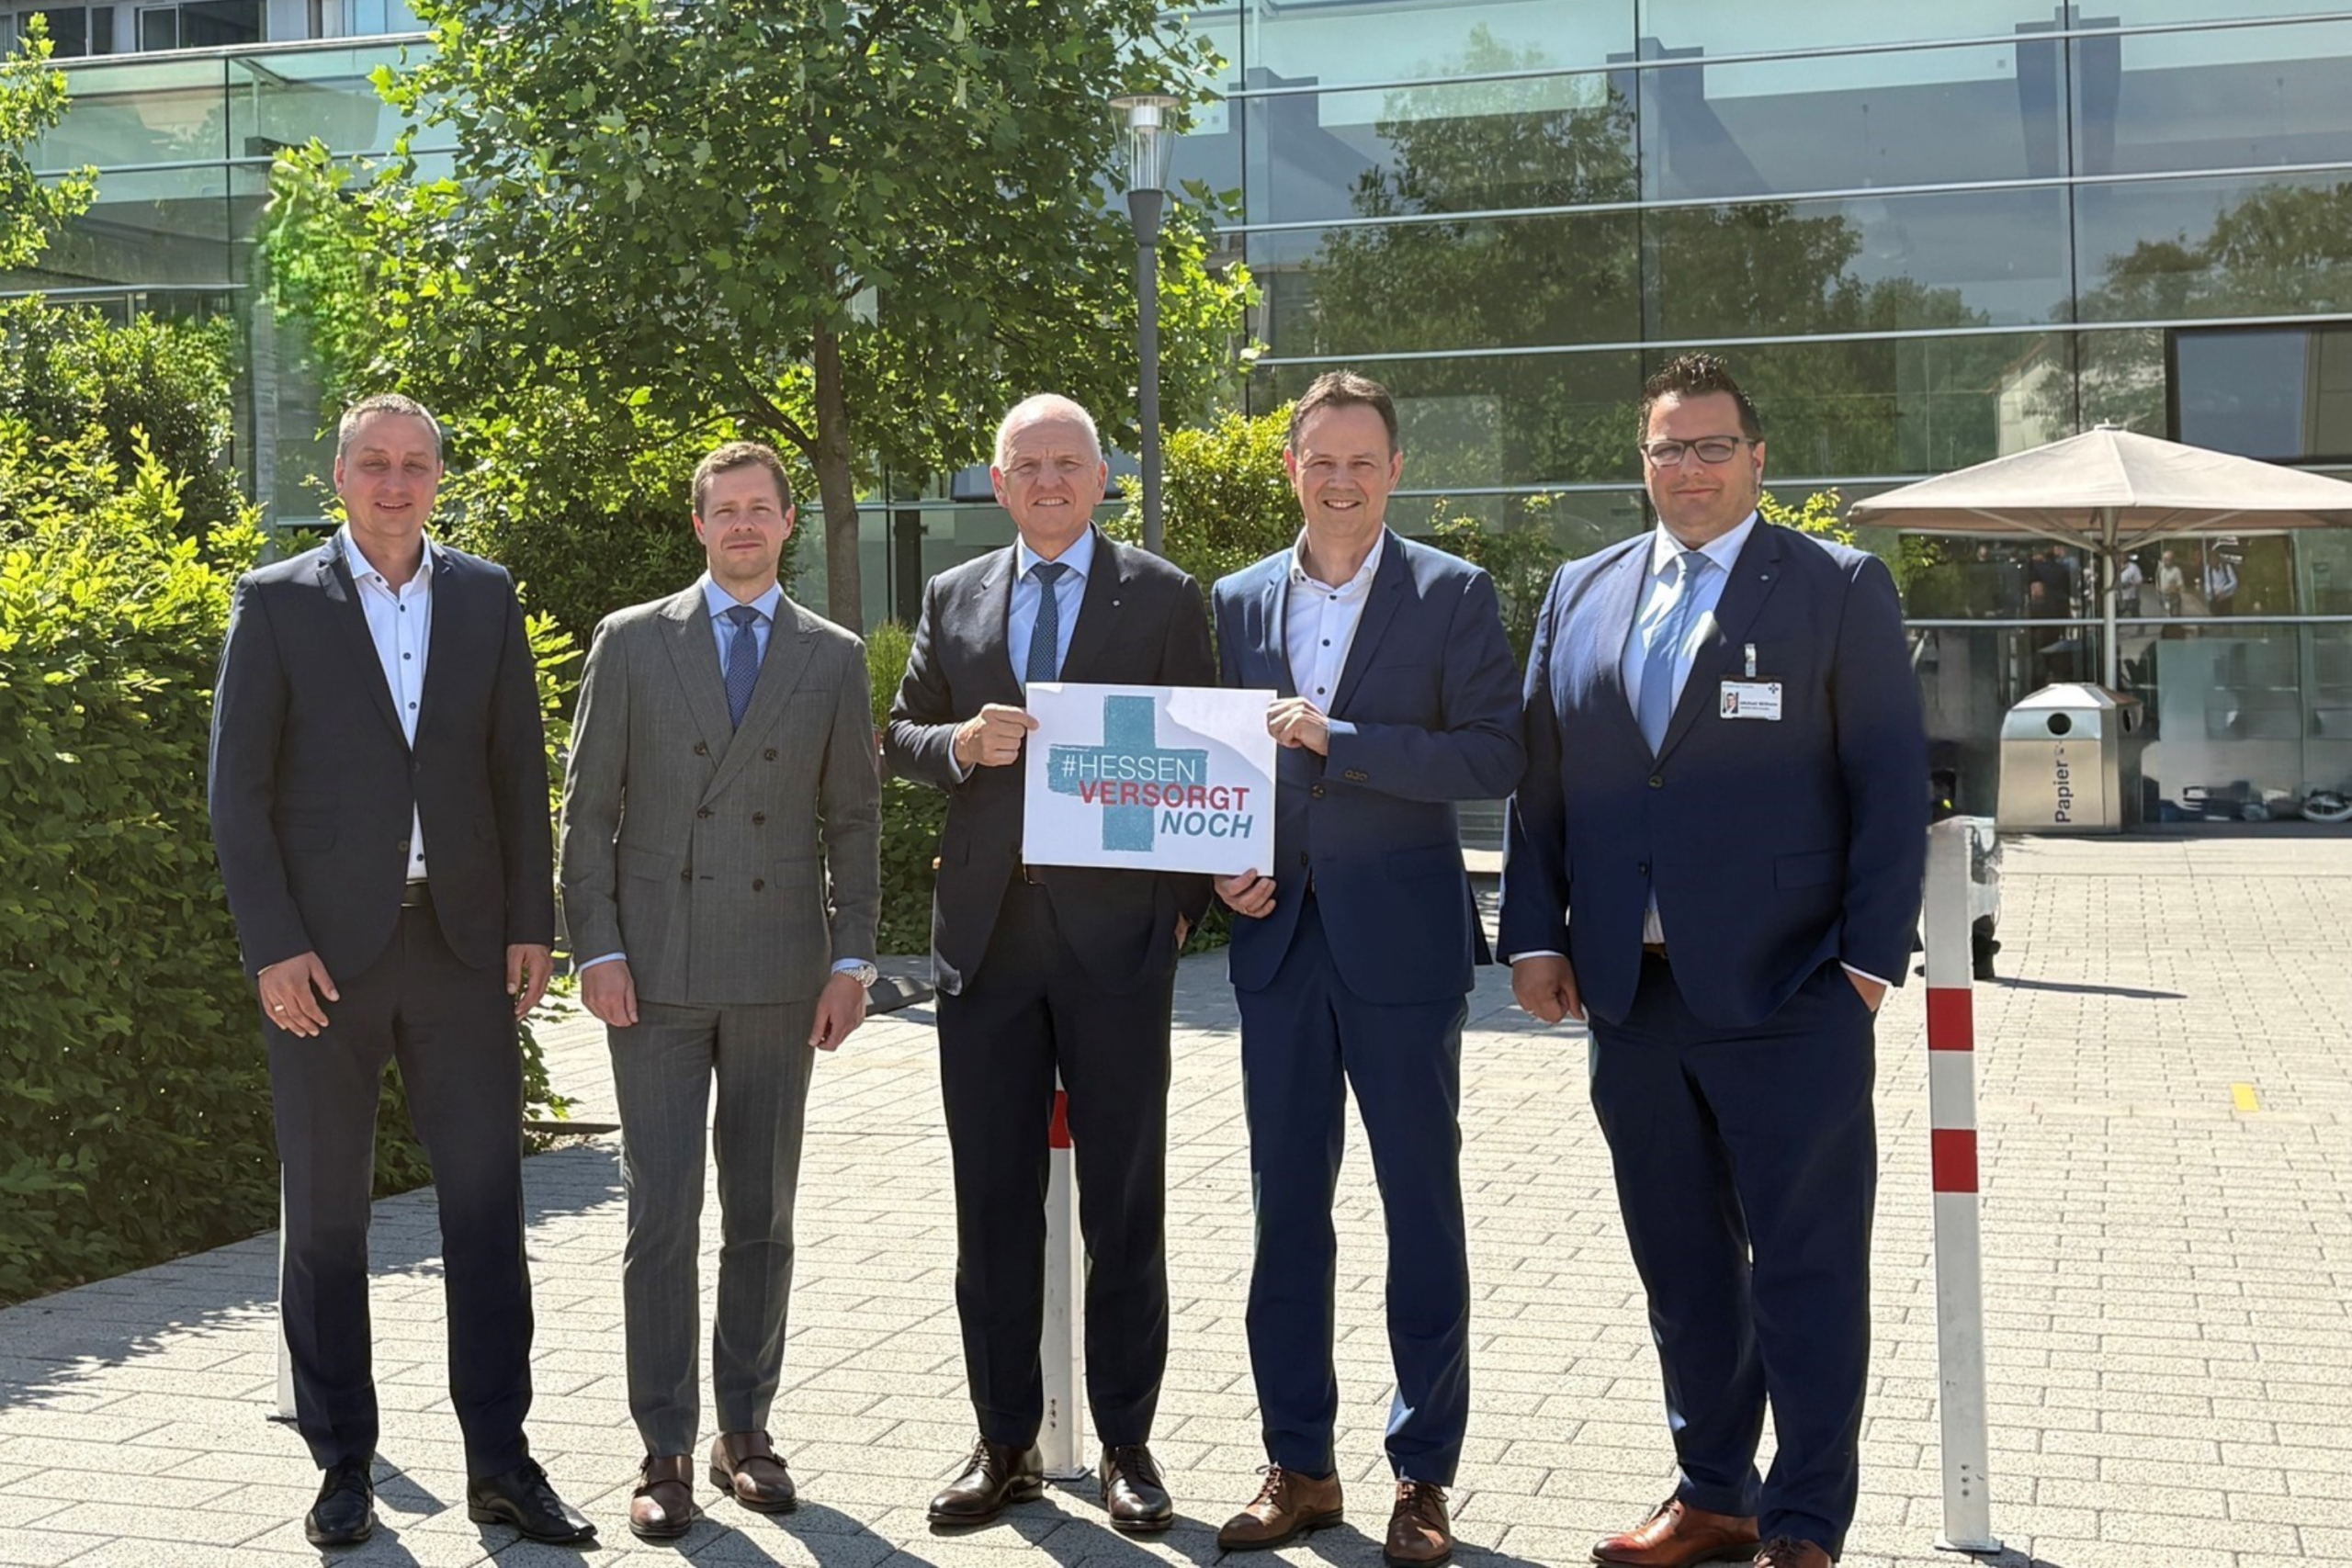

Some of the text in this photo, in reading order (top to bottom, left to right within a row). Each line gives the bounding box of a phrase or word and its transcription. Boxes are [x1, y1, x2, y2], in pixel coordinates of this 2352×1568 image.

[1061, 755, 1195, 782] #HESSEN
[1079, 781, 1250, 811] VERSORGT
[2052, 760, 2074, 823] Papier
[1160, 810, 1253, 839] NOCH
